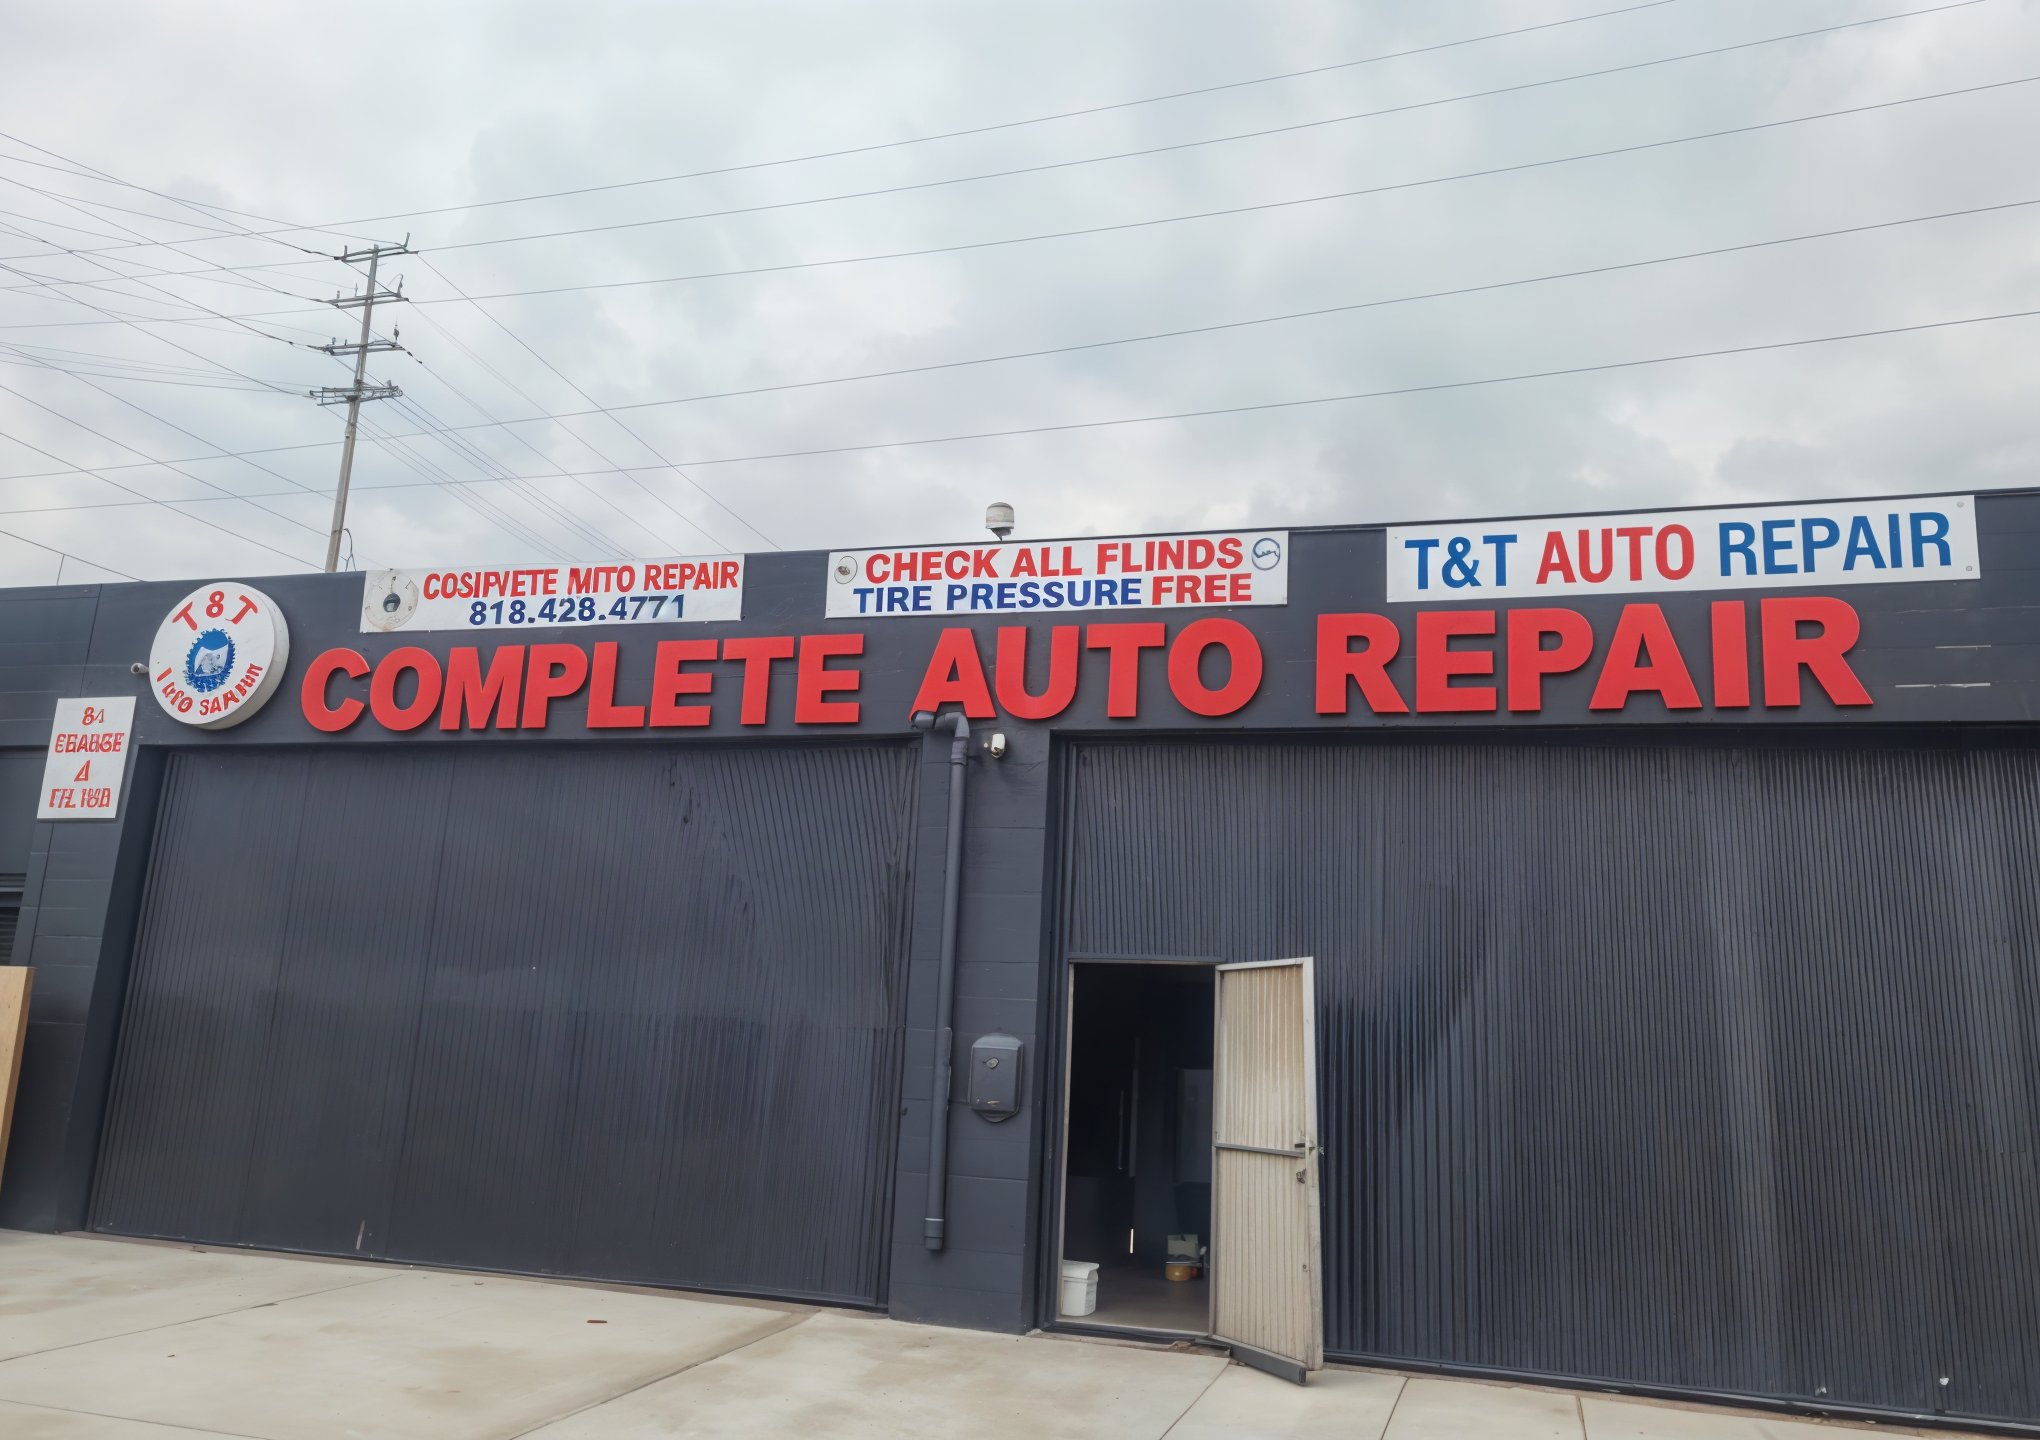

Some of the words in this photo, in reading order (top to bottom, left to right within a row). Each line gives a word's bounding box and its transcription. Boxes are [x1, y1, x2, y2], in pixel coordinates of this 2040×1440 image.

[865, 548, 1001, 584] CHECK
[1010, 546, 1083, 579] ALL
[1096, 537, 1244, 574] FLINDS
[1404, 533, 1518, 590] T&T
[1536, 523, 1695, 584] AUTO
[1719, 512, 1952, 576] REPAIR
[643, 561, 740, 591] REPAIR
[853, 585, 932, 614] TIRE
[946, 578, 1142, 611] PRESSURE
[1151, 572, 1253, 607] FREE
[469, 594, 685, 625] 818.428.4771
[301, 634, 865, 732] COMPLETE
[908, 617, 1263, 720] AUTO
[1315, 596, 1873, 714] REPAIR
